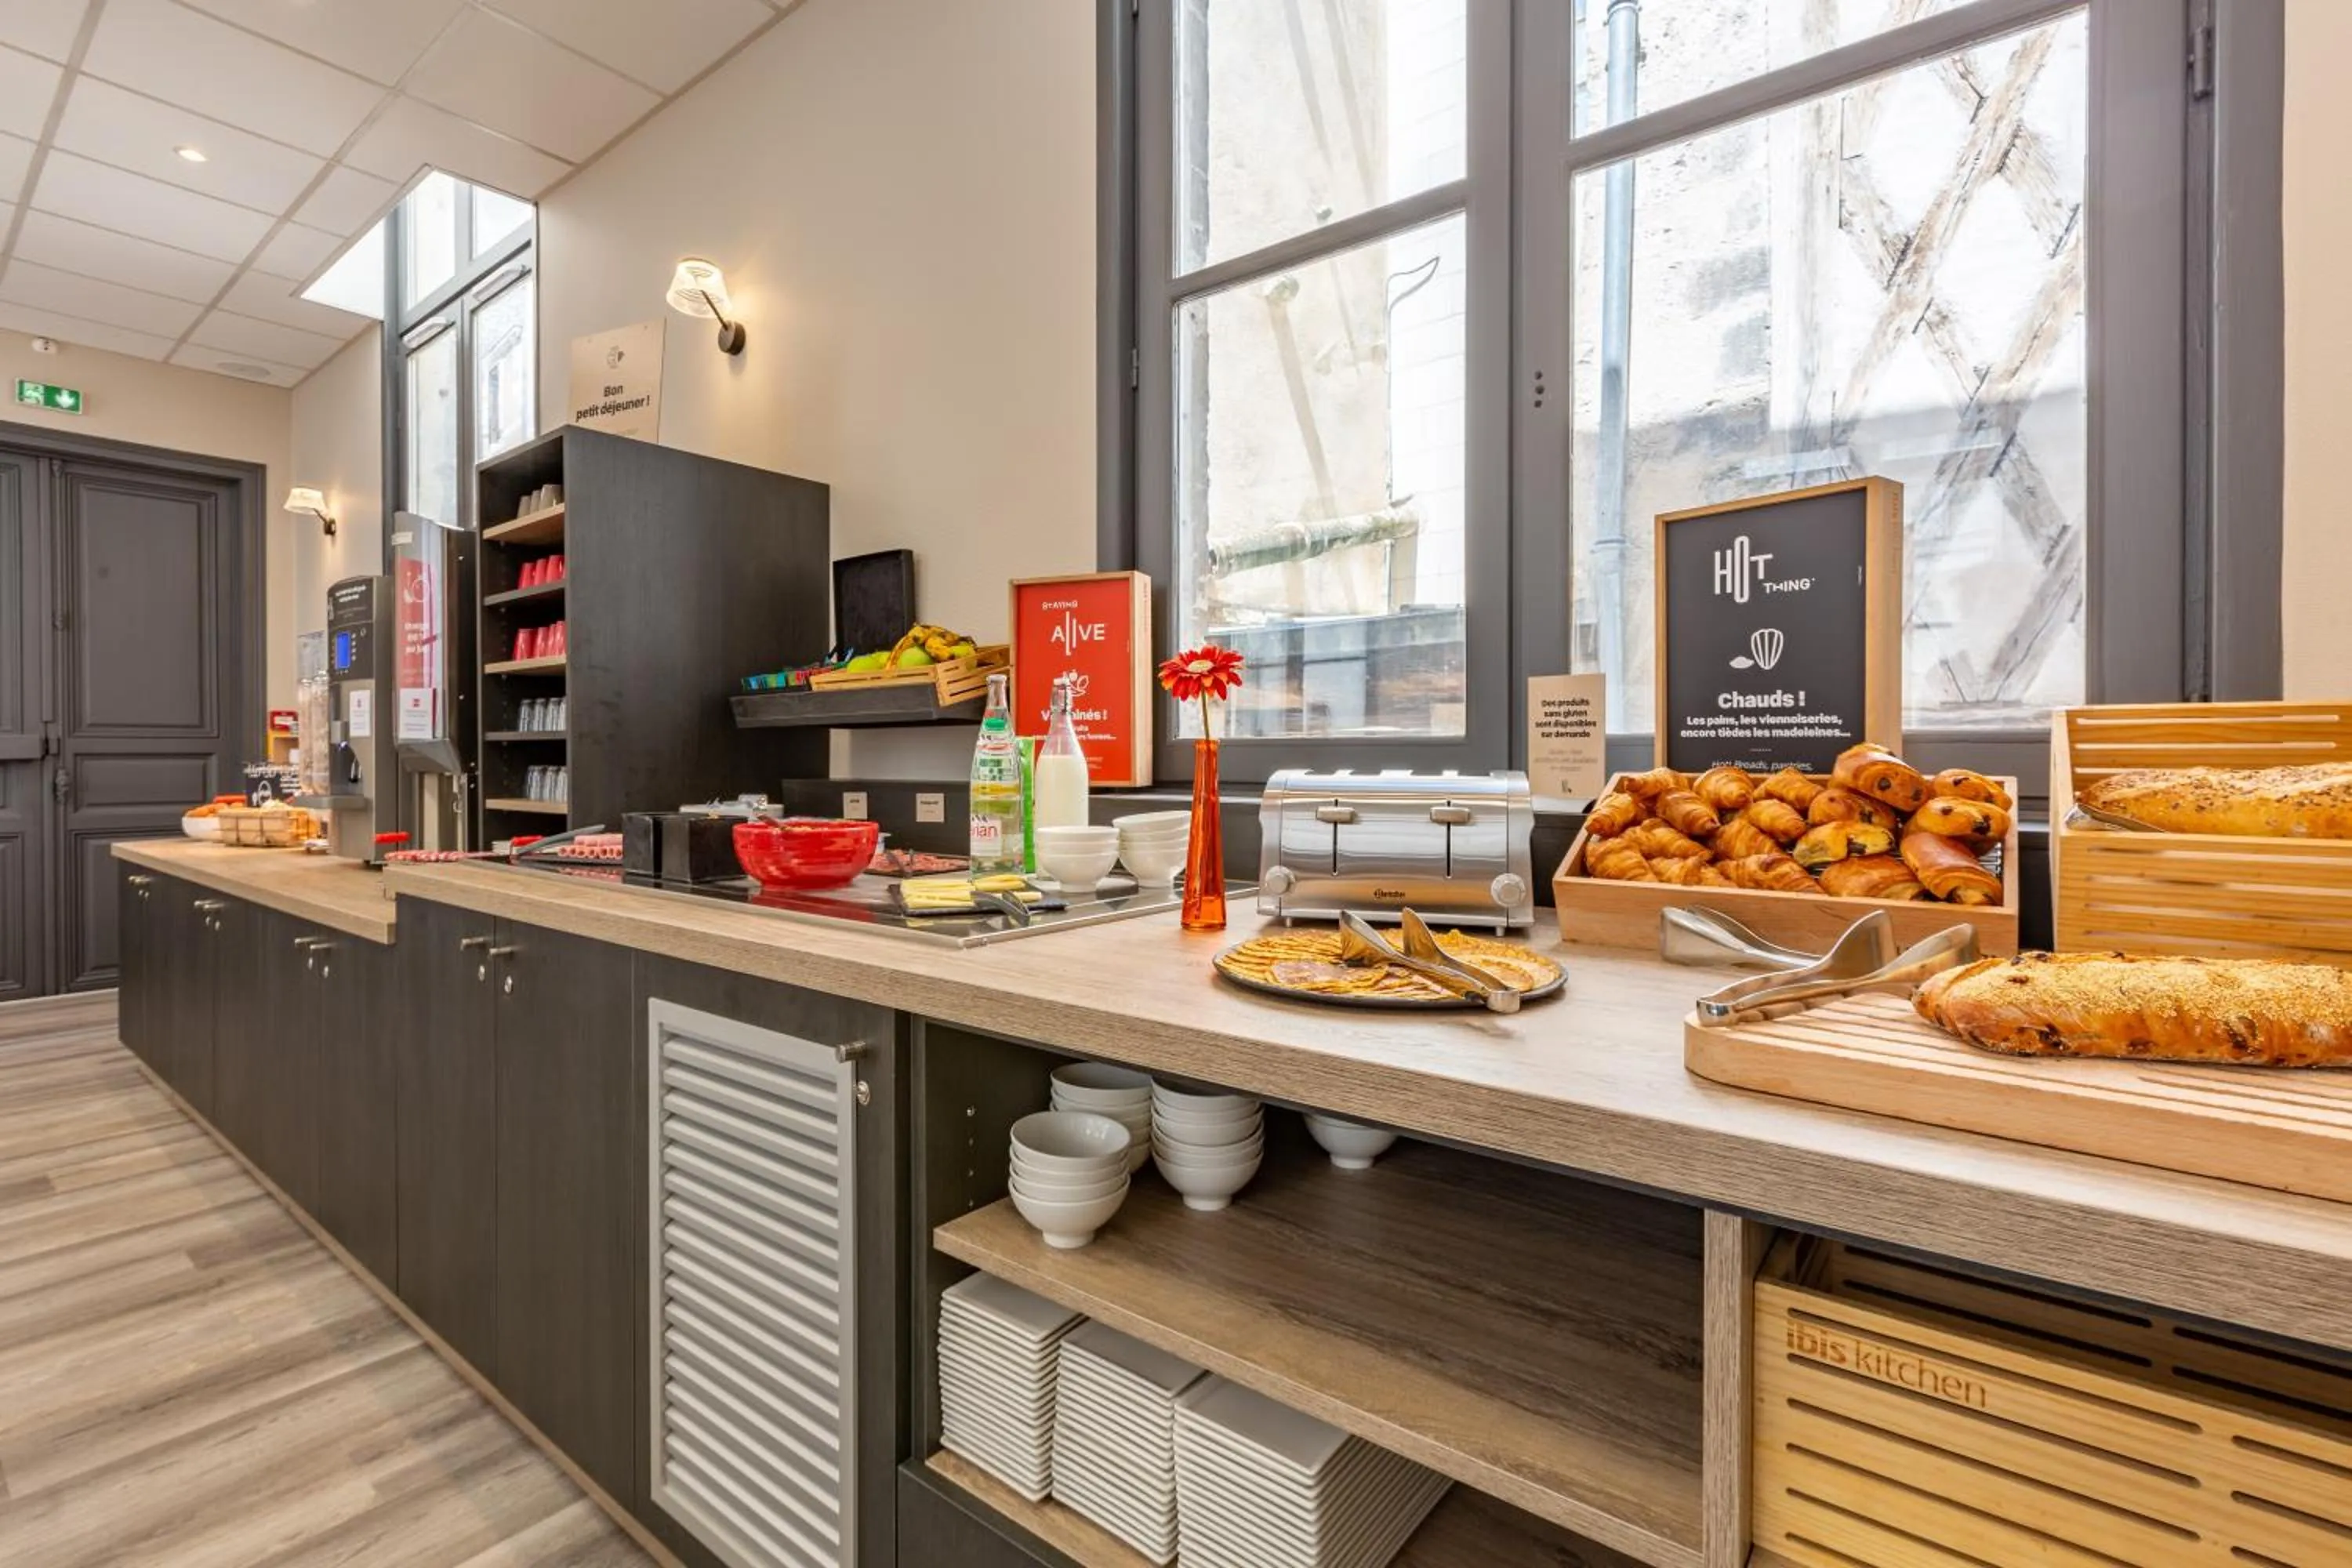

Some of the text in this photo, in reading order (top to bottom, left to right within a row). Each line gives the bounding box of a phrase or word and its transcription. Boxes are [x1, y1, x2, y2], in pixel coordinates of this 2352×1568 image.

[604, 385, 623, 397] Bon
[575, 404, 599, 423] petit
[600, 397, 645, 416] déjeuner
[1715, 535, 1773, 603] HOT
[1763, 578, 1811, 593] THING
[1558, 697, 1590, 707] produits
[1718, 689, 1806, 708] Chauds !
[1563, 709, 1588, 719] gluten
[1686, 713, 1842, 728] Les pains, les viennoiseries,
[1680, 729, 1716, 738] encore
[1718, 728, 1751, 738] tièdes
[1753, 727, 1770, 738] les
[1787, 1318, 1987, 1408] ibis kitchen
